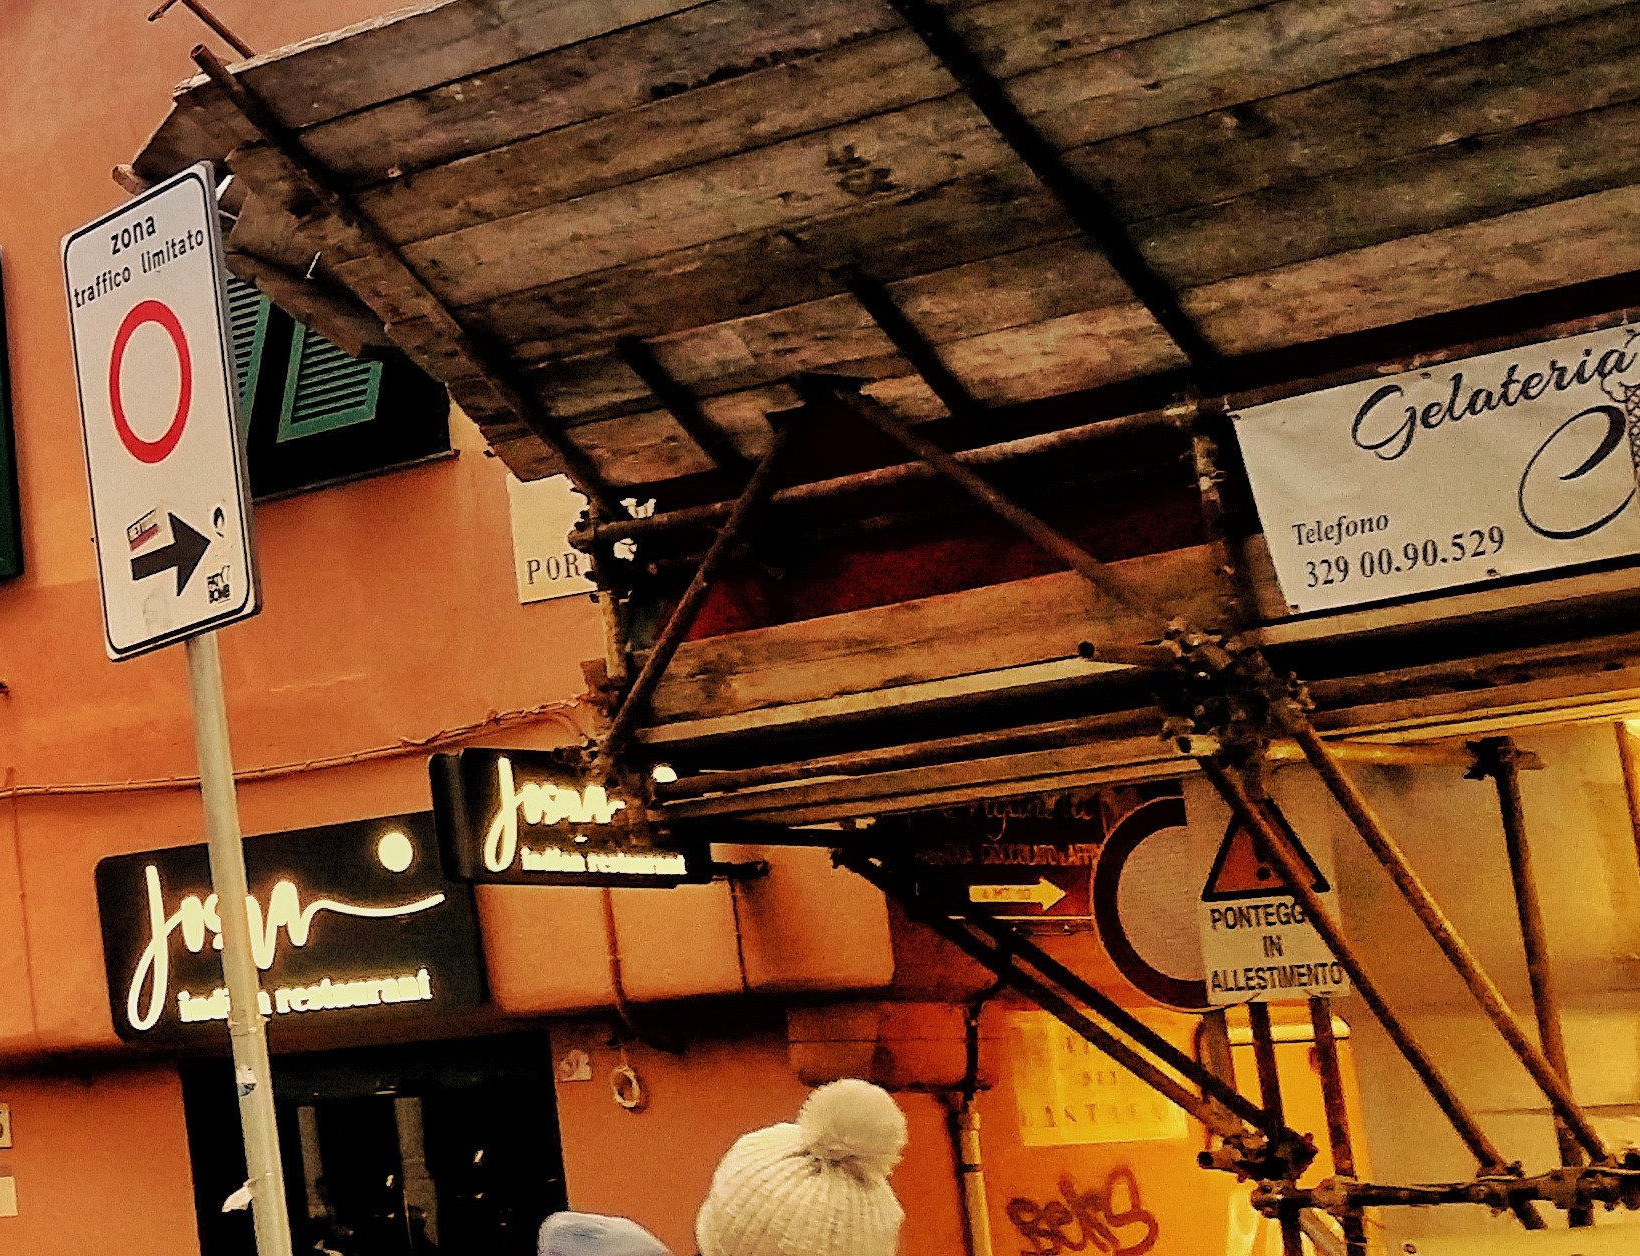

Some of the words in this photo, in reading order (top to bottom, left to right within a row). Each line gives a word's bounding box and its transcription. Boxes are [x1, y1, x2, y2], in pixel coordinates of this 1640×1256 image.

[109, 212, 157, 255] zona
[74, 265, 131, 308] traffico
[141, 227, 205, 274] limitato
[1352, 347, 1634, 461] Gelateria
[1292, 514, 1390, 546] Telefono
[526, 552, 583, 585] POR
[1306, 559, 1349, 588] 329
[1360, 526, 1505, 579] 00.90.529
[1210, 902, 1307, 930] PONTEGG
[1262, 935, 1284, 959] IN
[1211, 961, 1343, 993] ALLESTIMENTO
